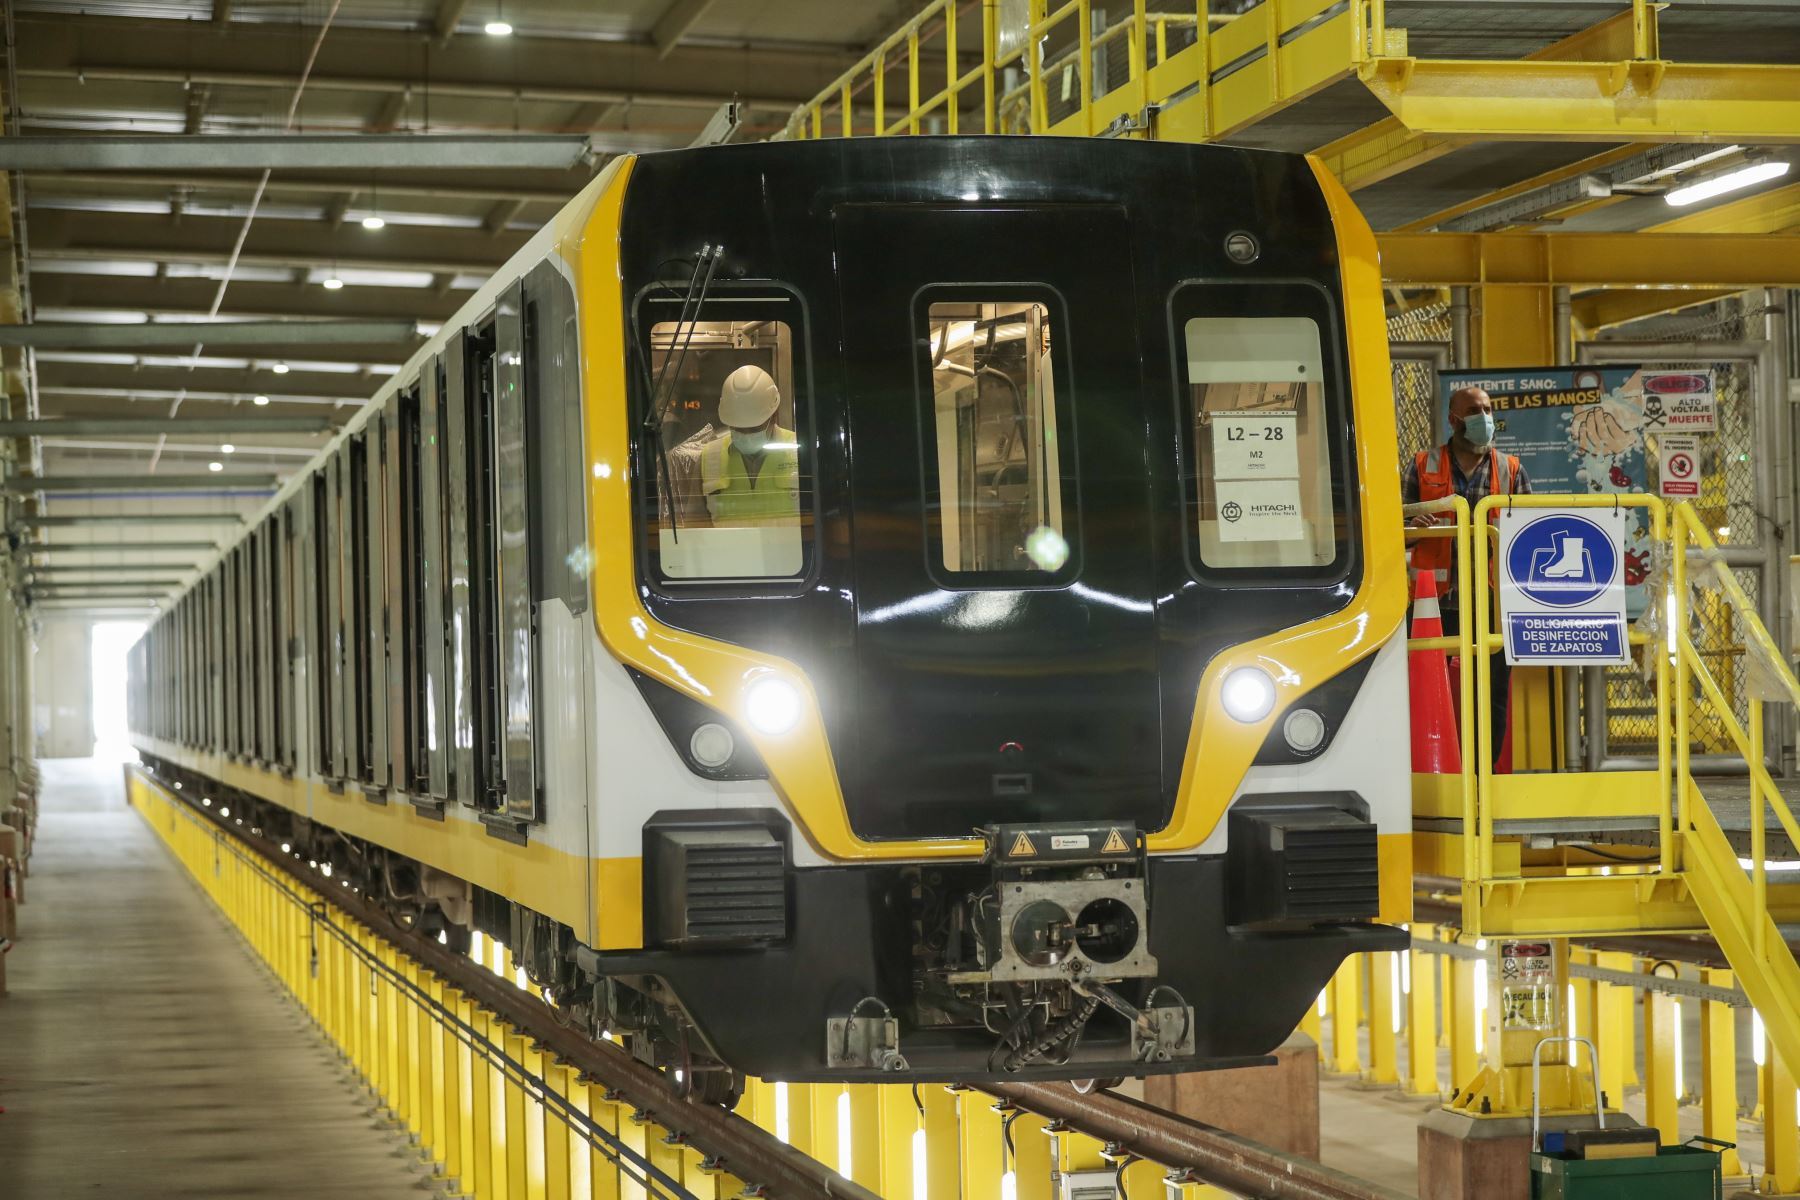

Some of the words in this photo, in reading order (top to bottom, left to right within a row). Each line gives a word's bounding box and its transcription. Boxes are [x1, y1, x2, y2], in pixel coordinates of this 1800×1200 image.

[1450, 379, 1515, 391] MANTENTE
[1520, 379, 1557, 389] SANO:
[1515, 395, 1542, 409] LAS
[1546, 390, 1601, 405] MANOS!
[1678, 398, 1702, 406] ALTO
[1670, 405, 1710, 413] VOLTAJE
[1668, 414, 1713, 424] MUERTE
[1227, 427, 1245, 441] L2
[1263, 426, 1284, 441] 28
[1249, 450, 1263, 459] M2
[1251, 504, 1295, 512] HITACHI
[1524, 618, 1604, 629] OBLIGATORIO
[1522, 630, 1609, 641] DESINFECCION
[1530, 642, 1548, 653] DE
[1549, 642, 1603, 653] ZAPATOS
